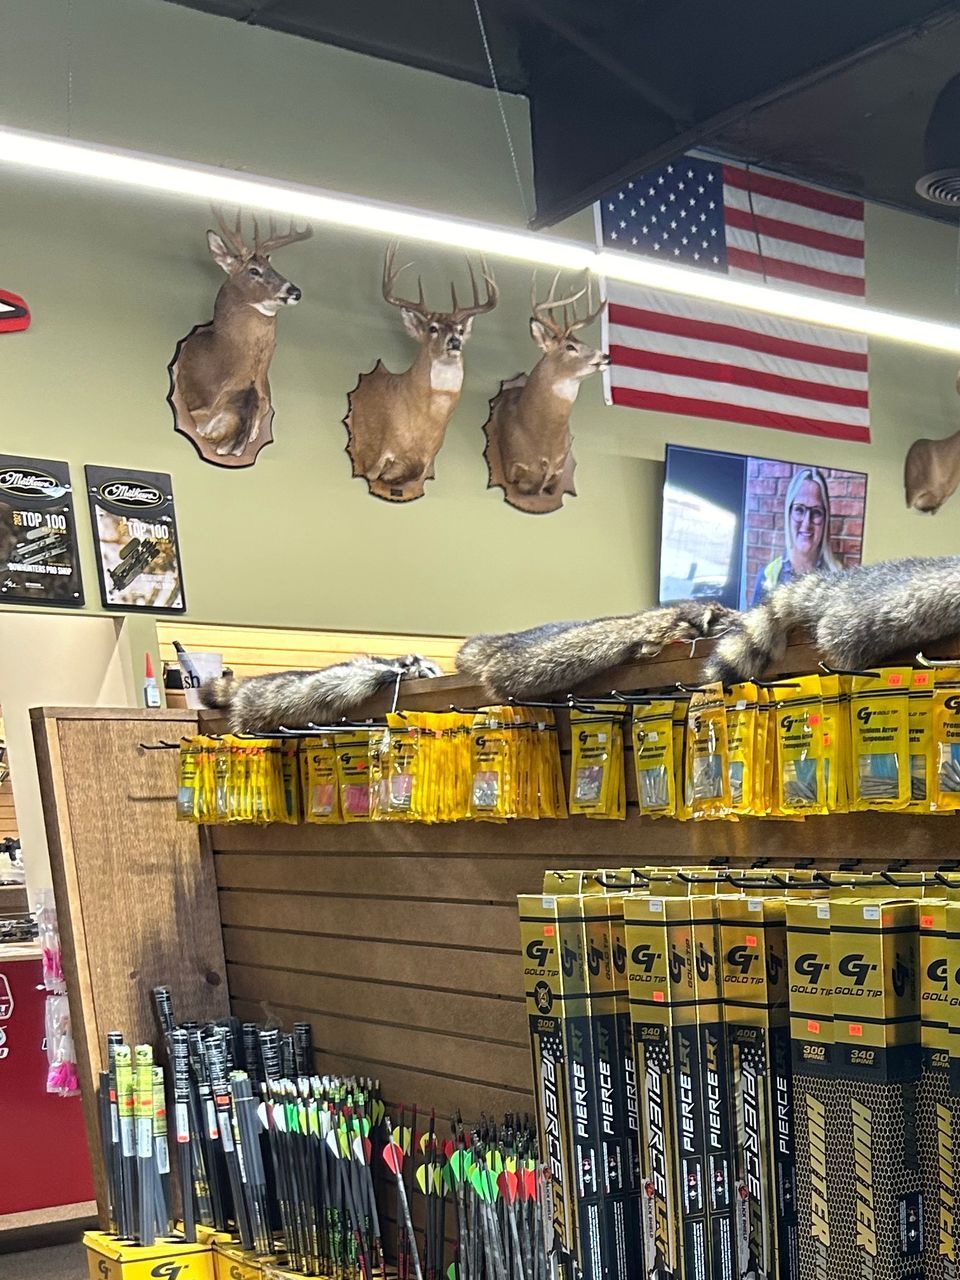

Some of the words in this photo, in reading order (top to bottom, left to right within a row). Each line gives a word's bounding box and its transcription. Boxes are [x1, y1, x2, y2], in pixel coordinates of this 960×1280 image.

[21, 511, 43, 528] TOP
[45, 514, 67, 530] 100
[127, 521, 147, 538] TOP
[149, 523, 169, 539] 100
[524, 968, 544, 977] GOLD
[546, 969, 560, 978] TIP
[628, 973, 651, 983] GOLD
[652, 975, 667, 984] TIP
[724, 974, 748, 984] GOLD
[749, 976, 764, 986] TIP
[790, 984, 817, 995] GOLD
[834, 986, 864, 997] GOLD
[866, 988, 883, 998] TIP
[537, 1019, 555, 1028] 300
[641, 1027, 660, 1036] 340
[736, 1029, 757, 1039] 400
[803, 1045, 826, 1055] 300
[850, 1049, 875, 1060] 340
[851, 1057, 874, 1066] SPINE
[572, 1059, 589, 1138] PIERCE
[599, 1058, 615, 1135] PIERCE
[679, 1071, 696, 1152] PIERCE
[706, 1068, 723, 1149] PIERCE
[776, 1075, 791, 1155] PIERCE
[541, 1058, 563, 1183] PIERCE
[645, 1058, 668, 1201] PIERCE
[741, 1062, 763, 1201] PIERCE
[805, 1092, 831, 1247] HUNTER
[850, 1097, 878, 1257] HUNTER
[935, 1102, 957, 1262] HUNTER
